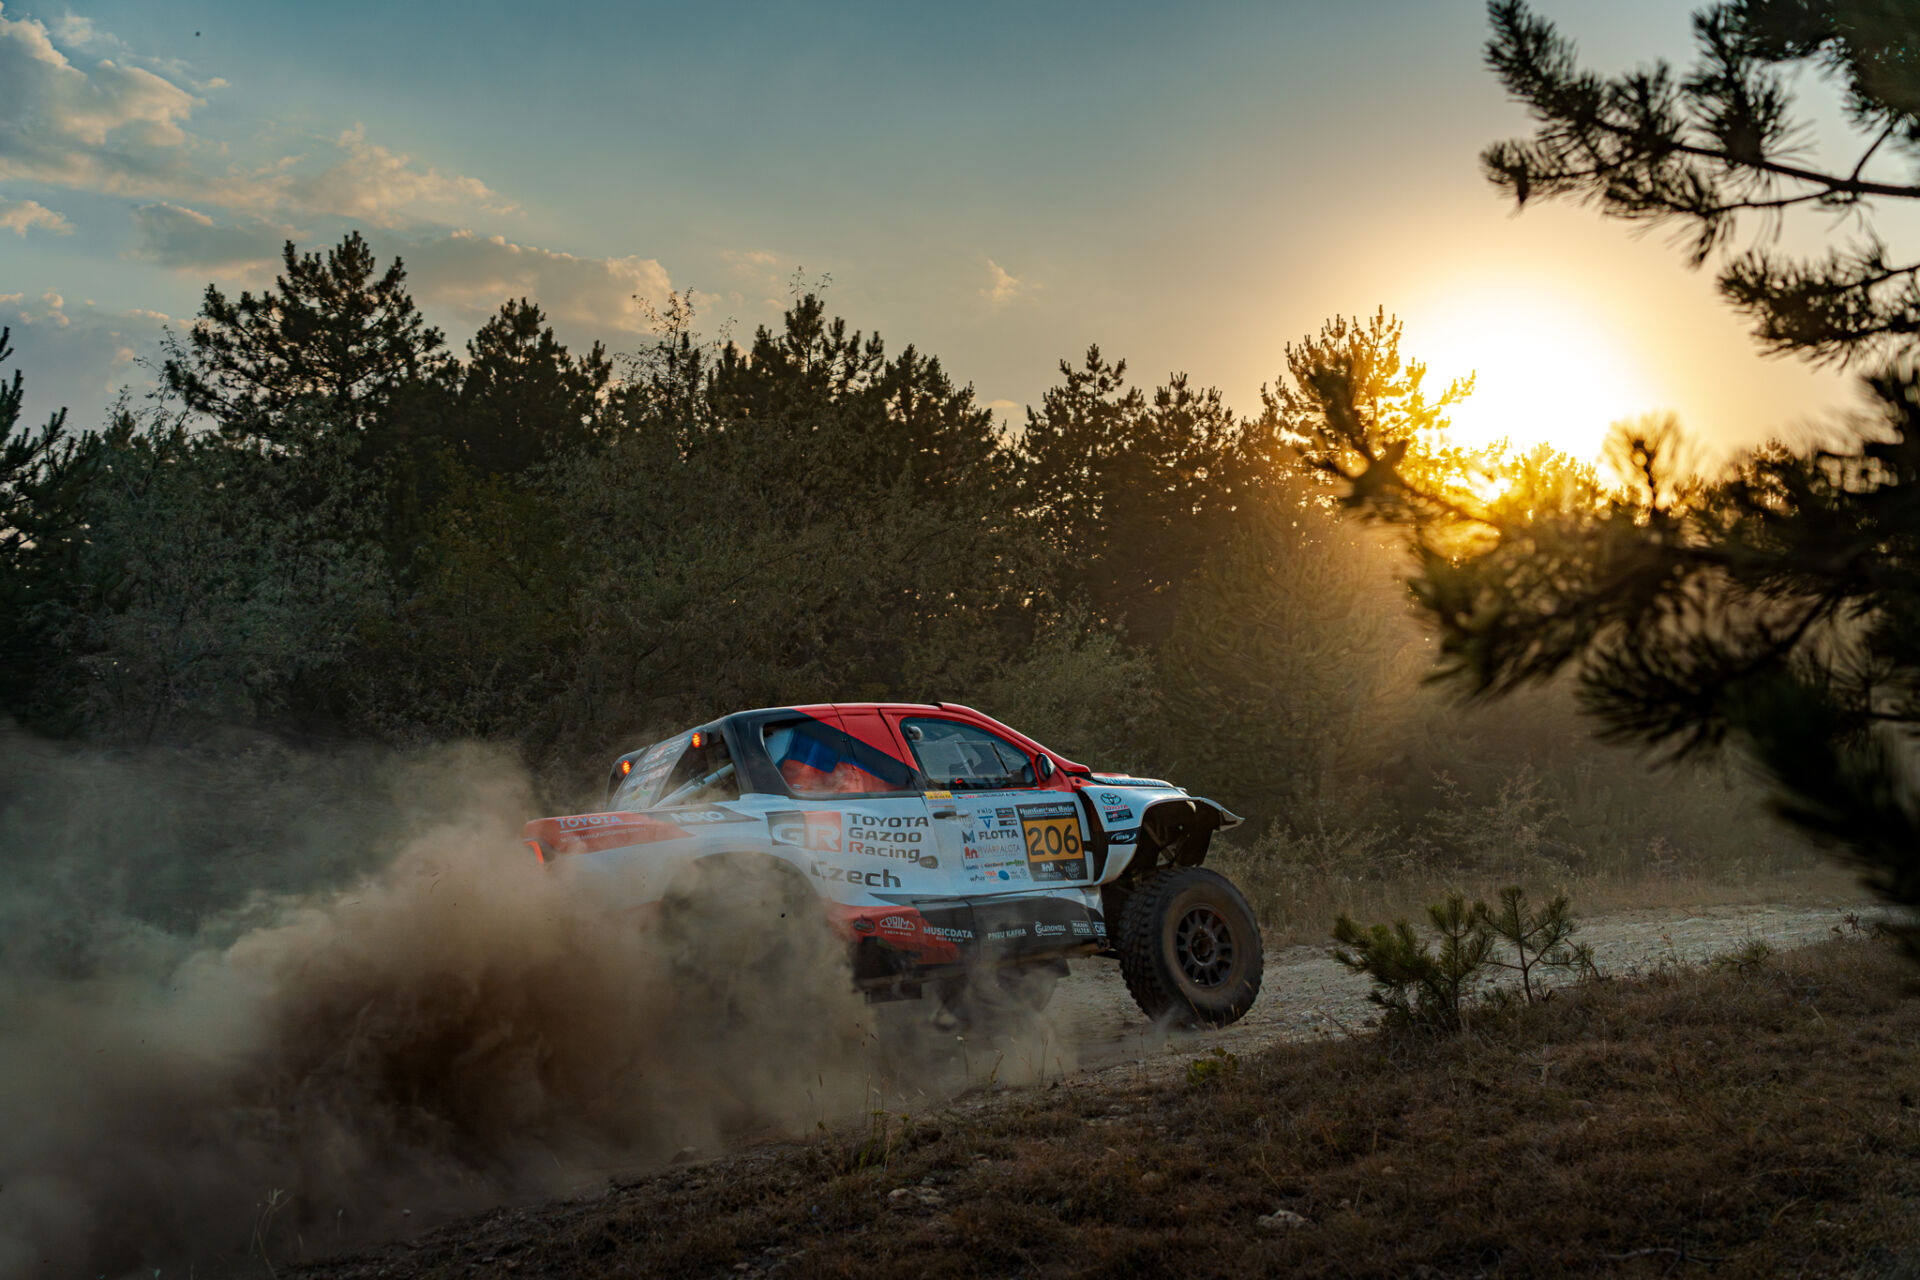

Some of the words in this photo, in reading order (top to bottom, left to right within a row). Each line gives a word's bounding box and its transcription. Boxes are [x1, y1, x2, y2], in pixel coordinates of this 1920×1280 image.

[556, 815, 624, 829] TOYOTA
[670, 811, 724, 823] NEXO
[847, 812, 930, 828] TOYOTA
[772, 823, 841, 852] GR
[848, 827, 922, 843] GAZOO
[979, 829, 1019, 841] FLOTTA
[1027, 823, 1080, 856] 206
[848, 841, 921, 864] Racing
[810, 859, 902, 888] Czech
[923, 925, 974, 939] MUSICDATA
